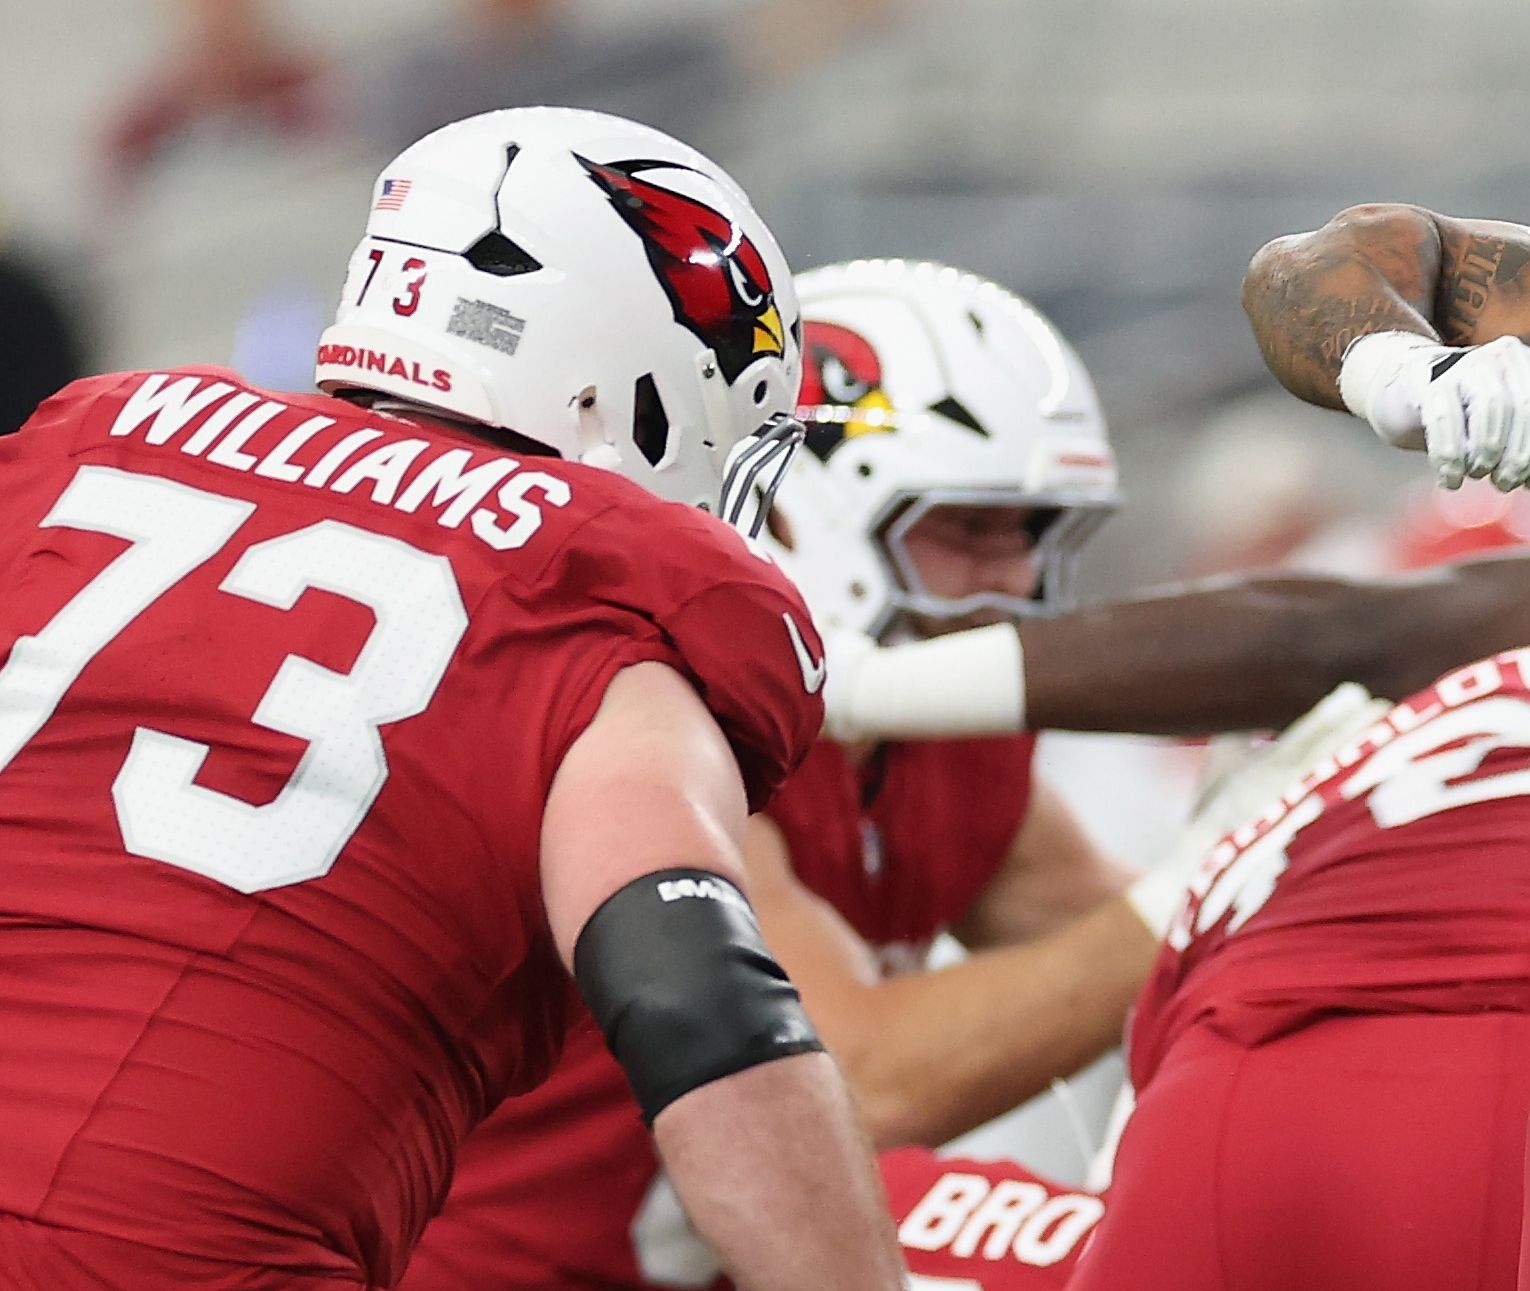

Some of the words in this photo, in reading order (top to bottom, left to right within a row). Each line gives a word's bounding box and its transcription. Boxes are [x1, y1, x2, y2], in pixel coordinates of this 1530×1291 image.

[355, 248, 427, 317] 73
[110, 373, 571, 551] WILLIAMS
[0, 464, 470, 895] 73
[899, 1171, 1106, 1268] BRO
